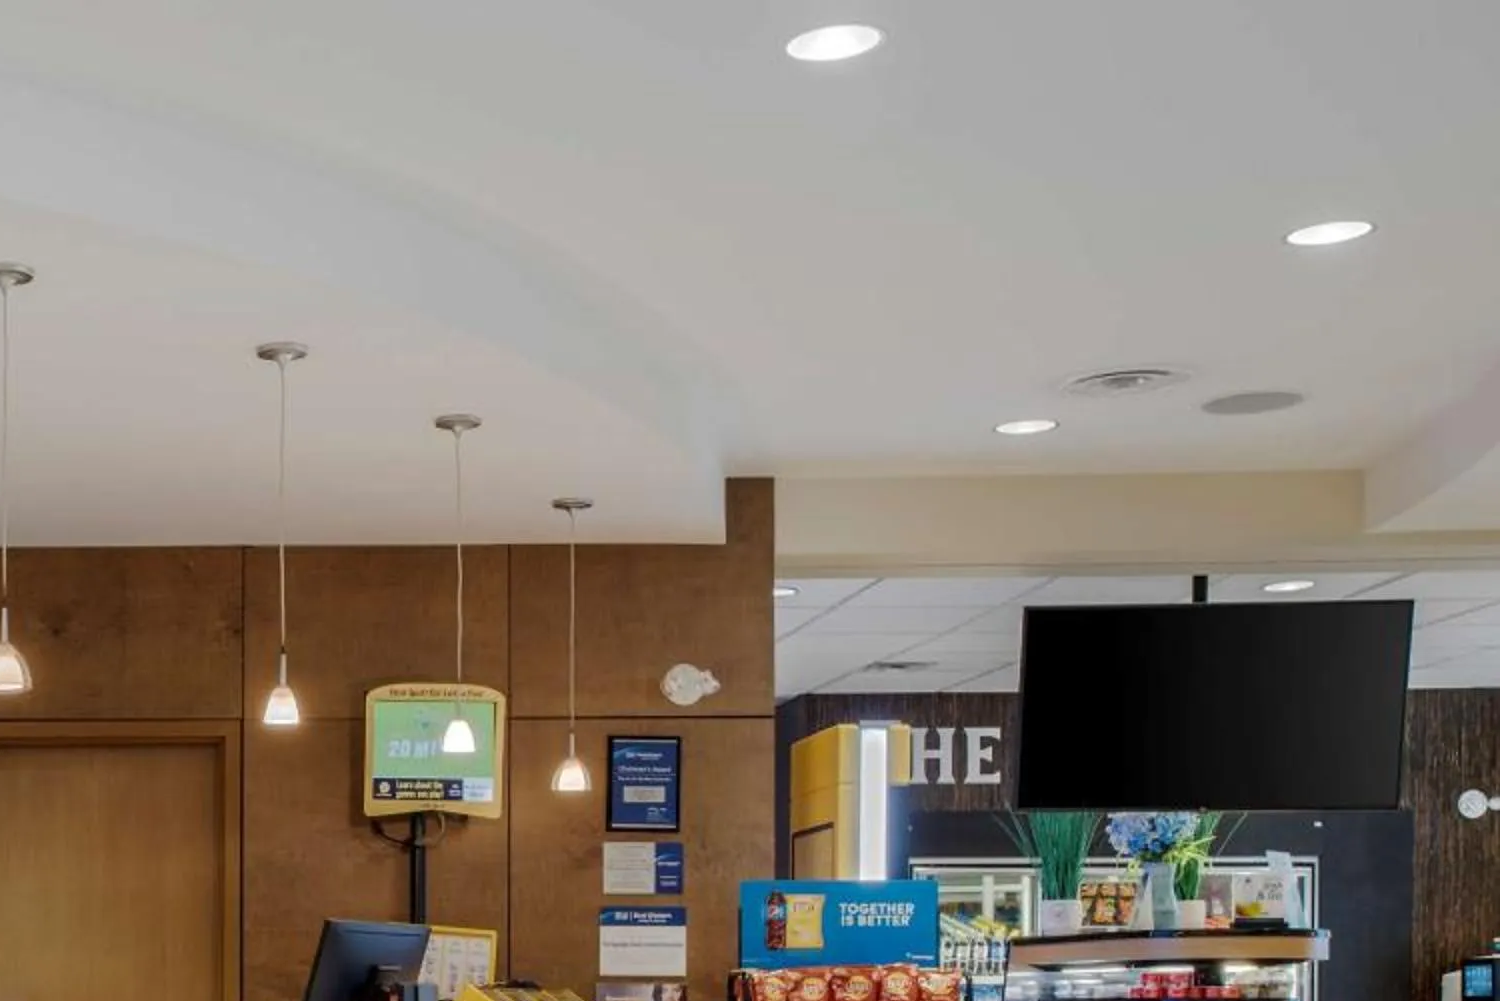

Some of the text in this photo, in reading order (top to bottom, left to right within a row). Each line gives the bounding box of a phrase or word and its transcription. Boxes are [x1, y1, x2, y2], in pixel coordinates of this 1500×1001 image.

[839, 902, 915, 916] TOGETHER
[841, 915, 911, 927] IS BETTER
